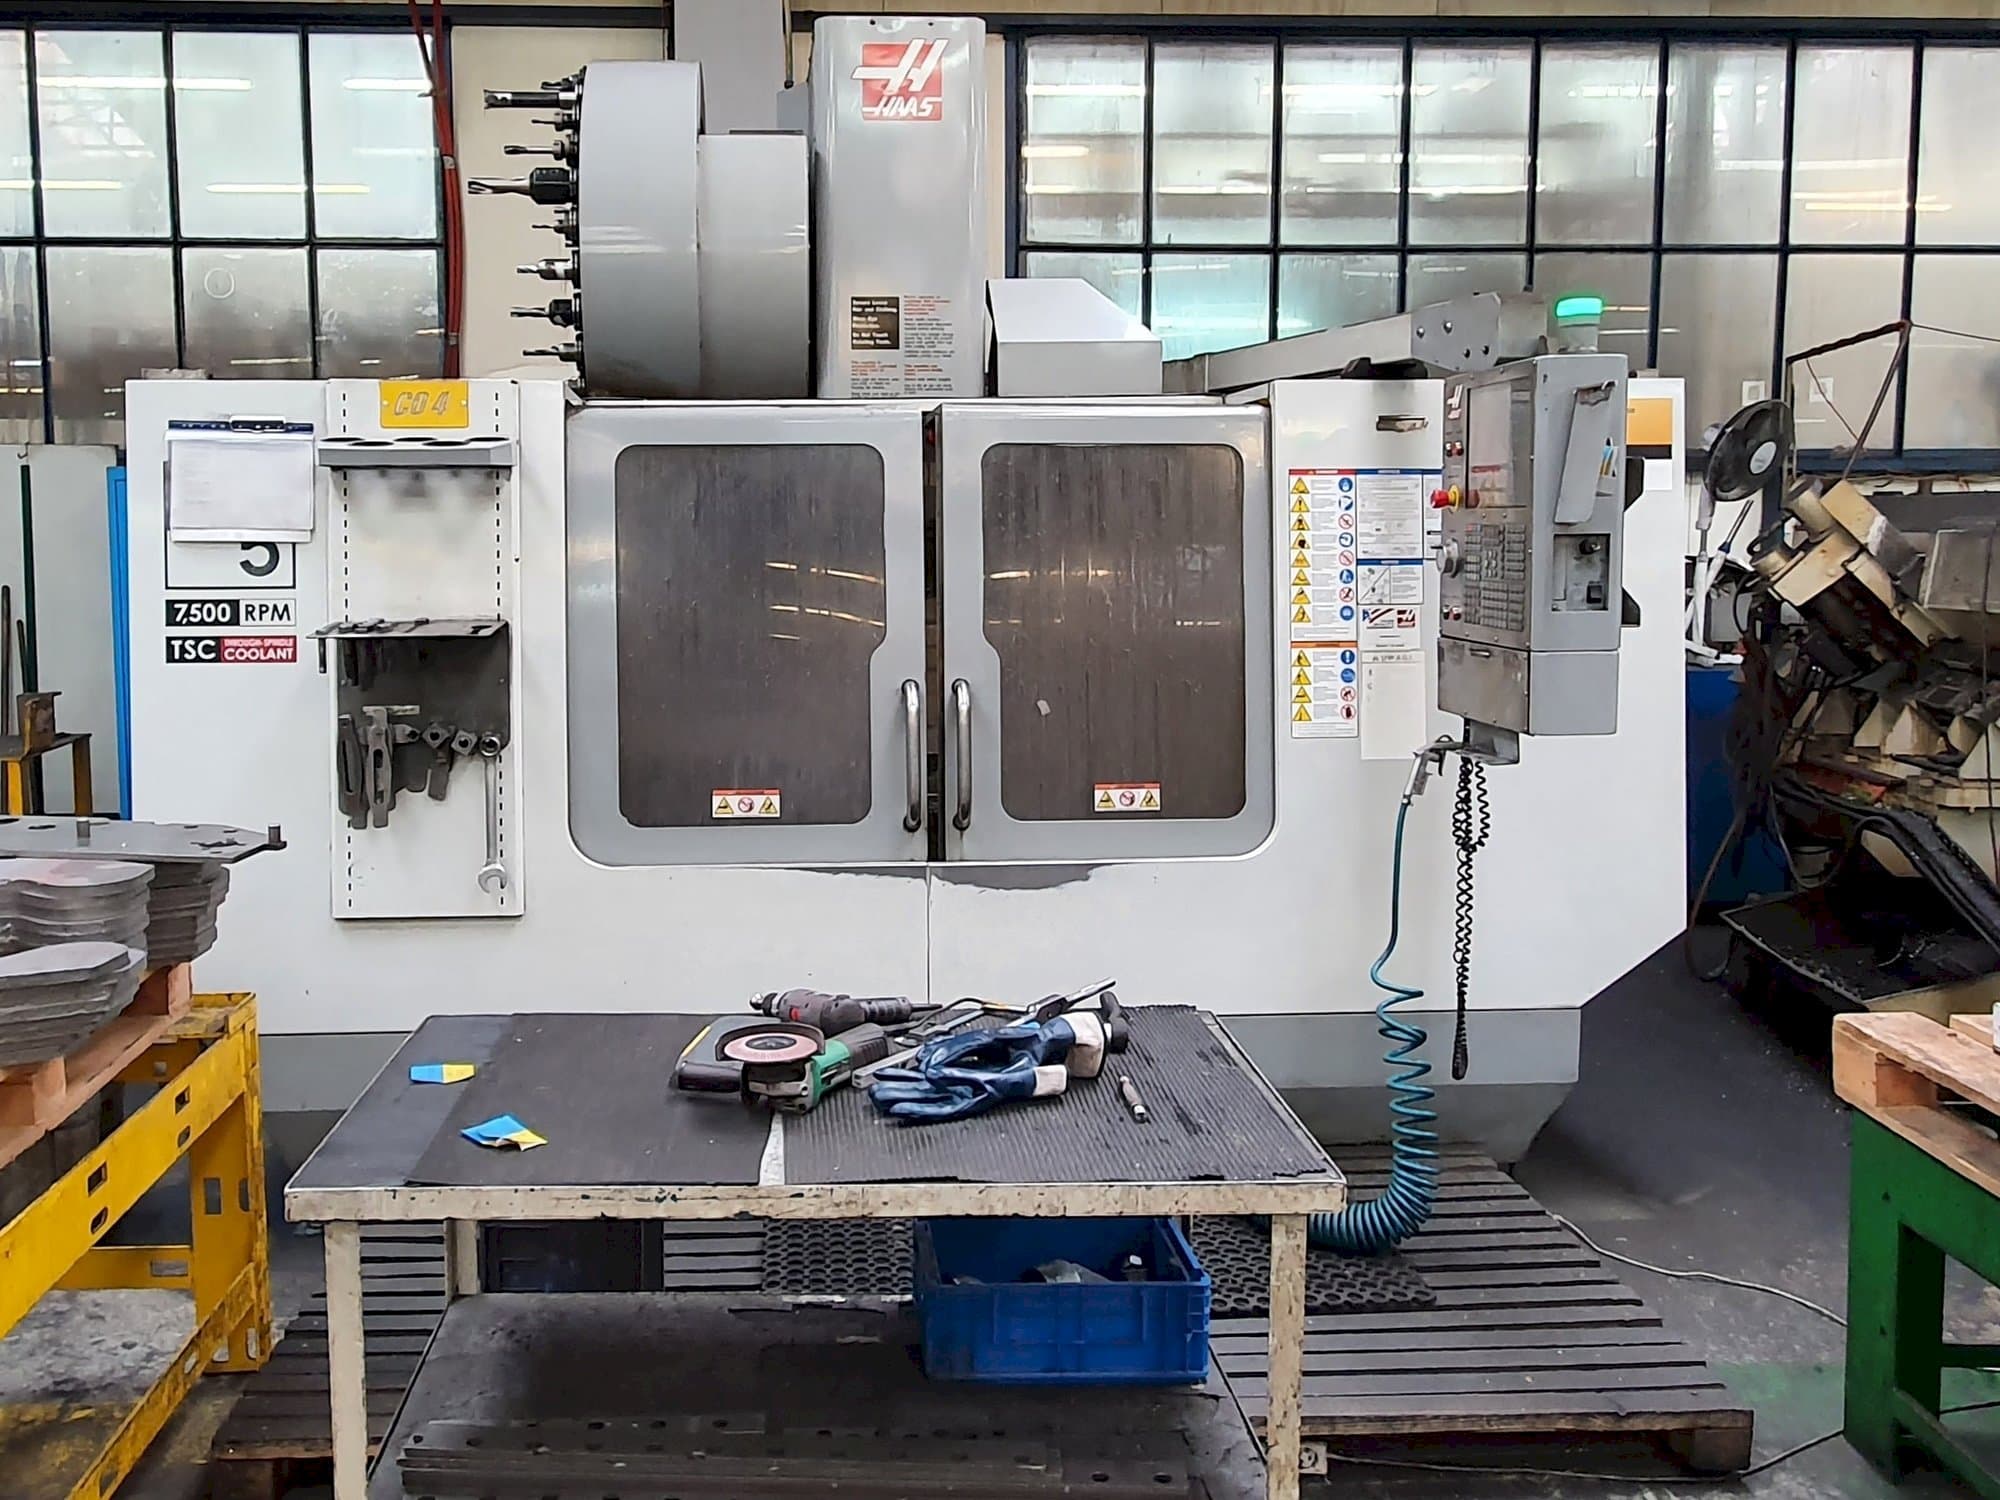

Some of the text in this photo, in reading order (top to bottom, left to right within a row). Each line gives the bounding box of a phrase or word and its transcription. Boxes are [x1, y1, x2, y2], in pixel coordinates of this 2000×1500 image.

[862, 96, 942, 117] HAAS
[173, 603, 291, 625] 7,500 RPM
[171, 639, 217, 660] TSC
[223, 647, 294, 660] COOLANT
